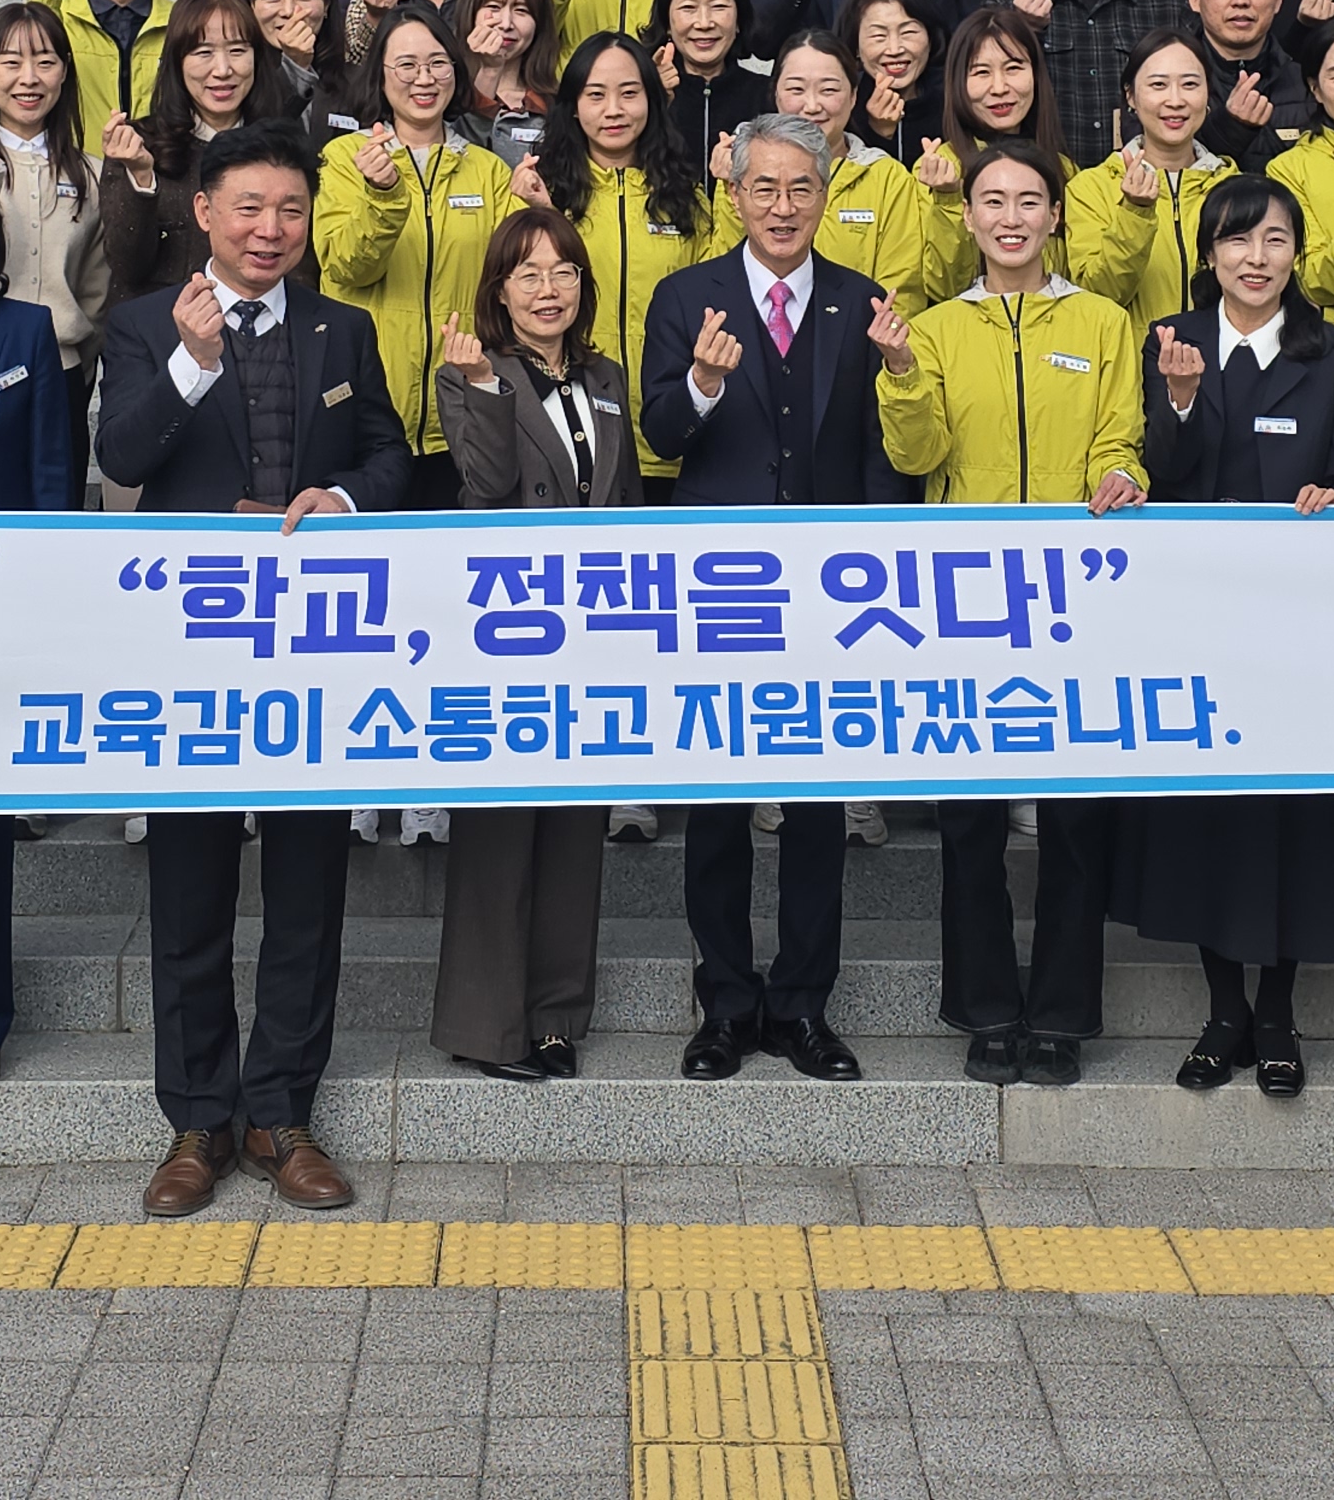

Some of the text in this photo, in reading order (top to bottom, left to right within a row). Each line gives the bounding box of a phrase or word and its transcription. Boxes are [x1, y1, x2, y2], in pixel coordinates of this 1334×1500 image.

[468, 552, 791, 657] 정책을
[821, 548, 1128, 650] 잇다!”
[11, 675, 1242, 767] 교육감이 소통하고 지원하겠습니다.
